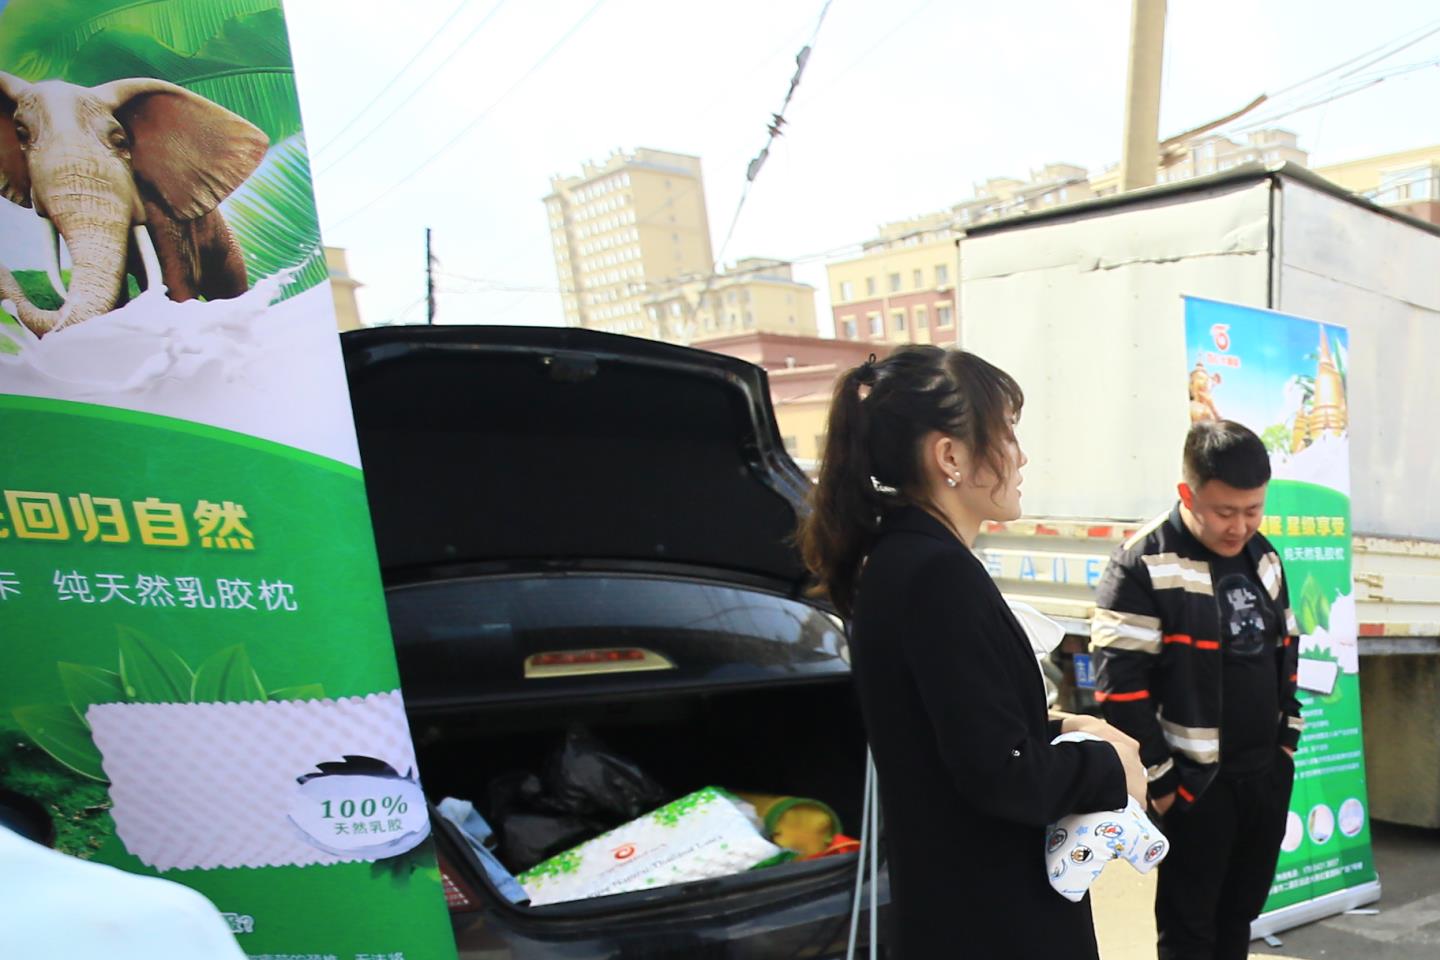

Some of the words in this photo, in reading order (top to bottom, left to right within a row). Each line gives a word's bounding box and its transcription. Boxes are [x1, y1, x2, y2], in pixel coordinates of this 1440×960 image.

[0, 490, 255, 550] 回归自然
[53, 569, 298, 611] 纯天然乳胶枕
[321, 795, 408, 819] 100%
[335, 819, 402, 835] 天然乳胶
